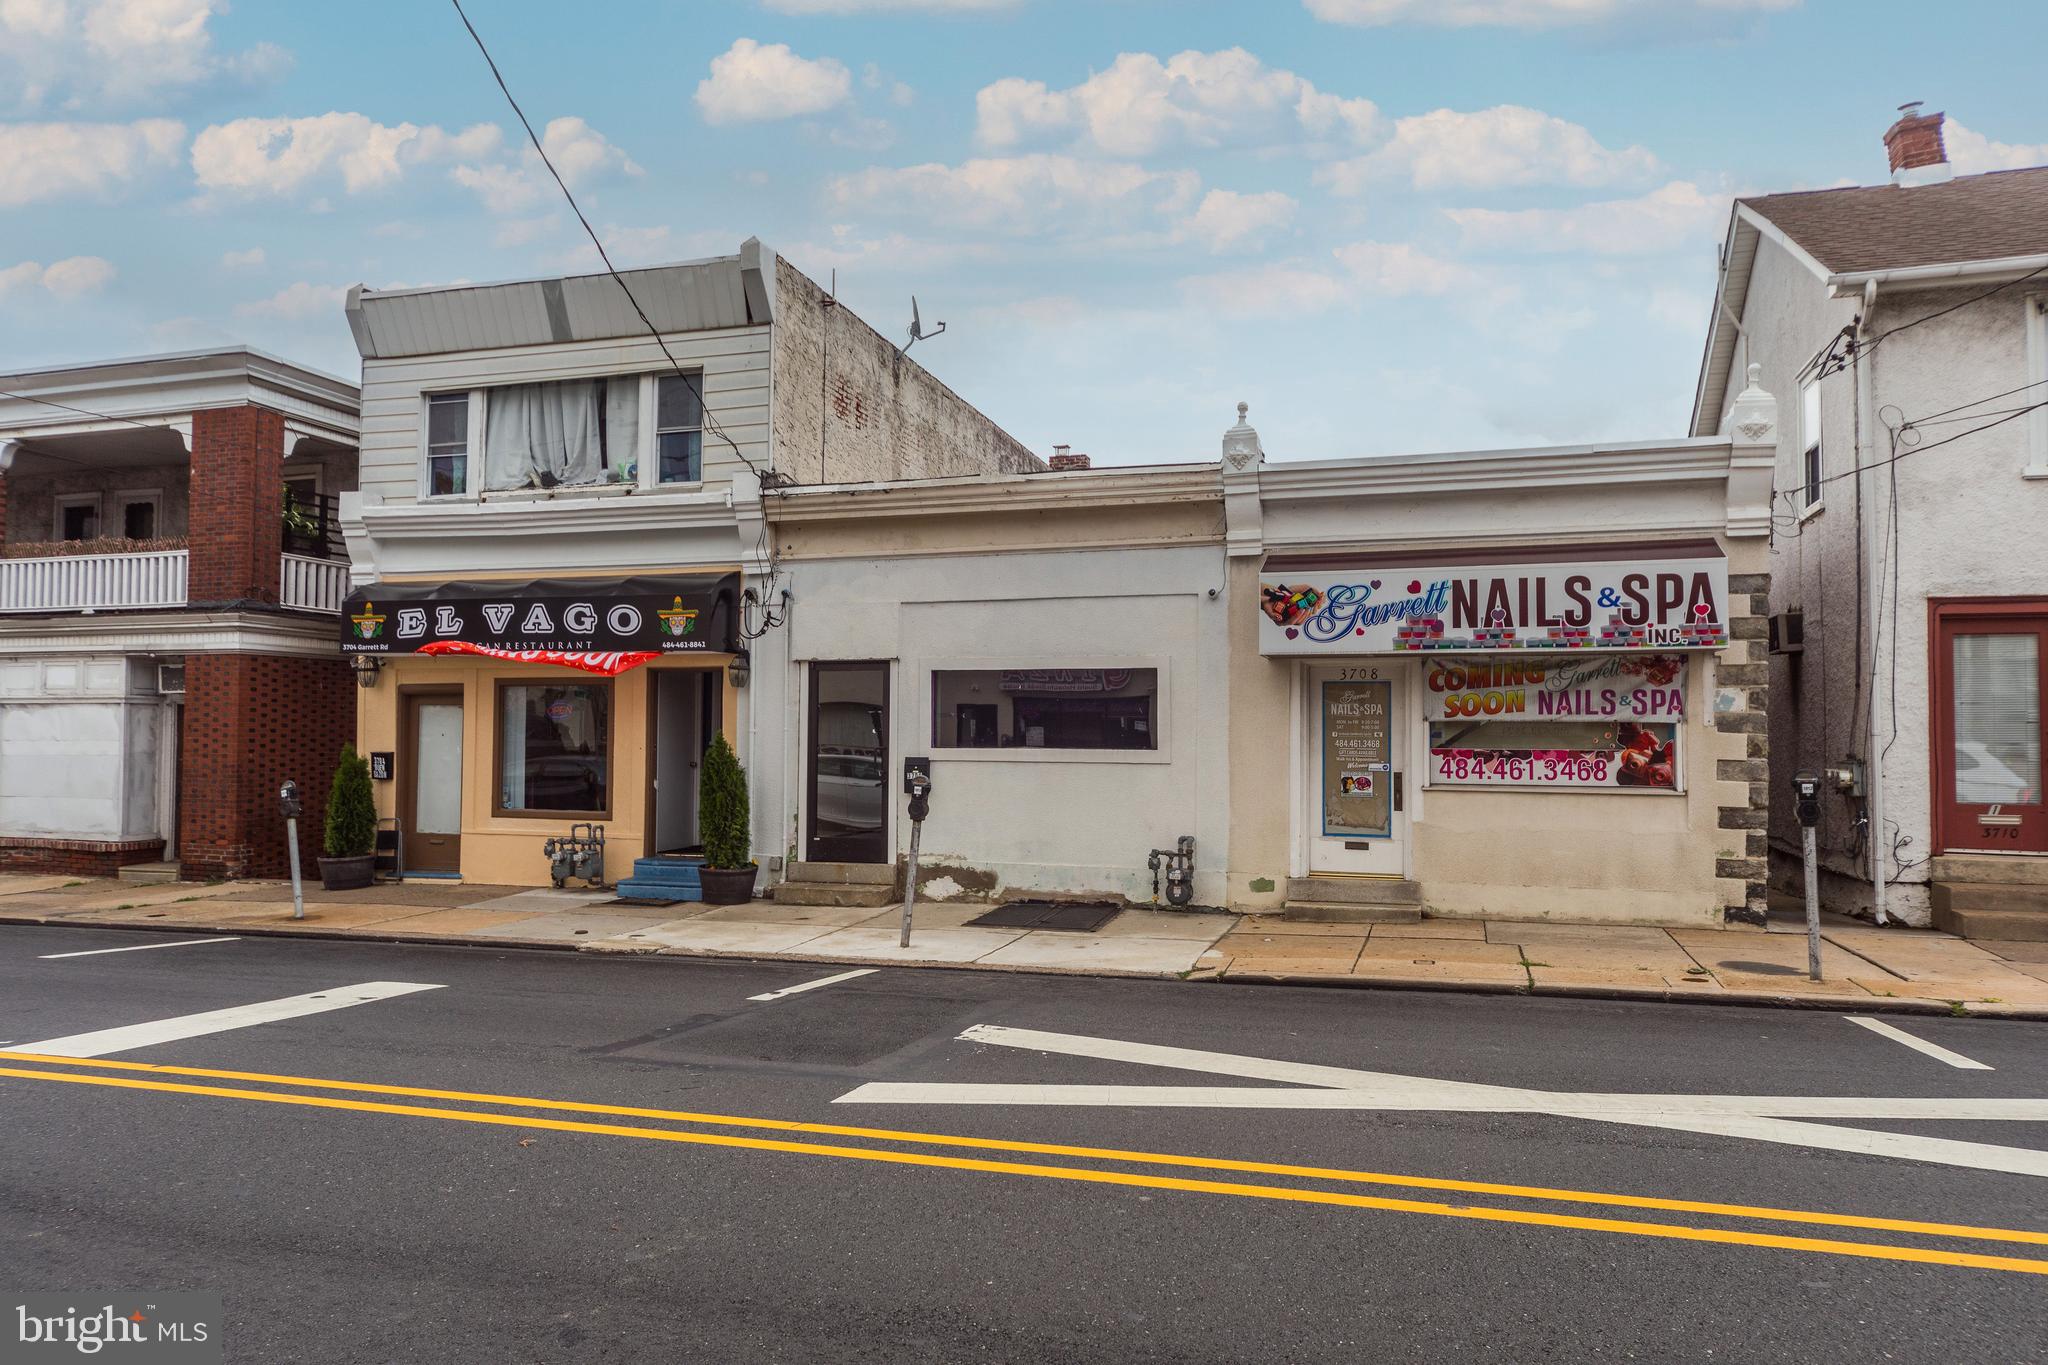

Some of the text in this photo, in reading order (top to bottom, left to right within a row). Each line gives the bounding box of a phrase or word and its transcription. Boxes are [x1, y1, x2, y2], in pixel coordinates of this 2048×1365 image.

[1303, 572, 1718, 643] Garrett NAILS & SPA
[397, 603, 642, 639] EL VAGO
[357, 643, 379, 651] Garrett
[505, 641, 592, 650] RESTAURANT
[1340, 668, 1378, 680] 3708
[1428, 660, 1546, 692] COMING
[1545, 656, 1622, 692] Garrett
[547, 705, 573, 715] OPEN
[1330, 703, 1359, 715] NAILS
[1364, 703, 1383, 715] SPA
[1444, 689, 1525, 718] SOON
[1538, 689, 1683, 716] NAILS & SPA
[1335, 739, 1380, 748] 484.461.3468
[1439, 758, 1608, 781] 484.461.3468
